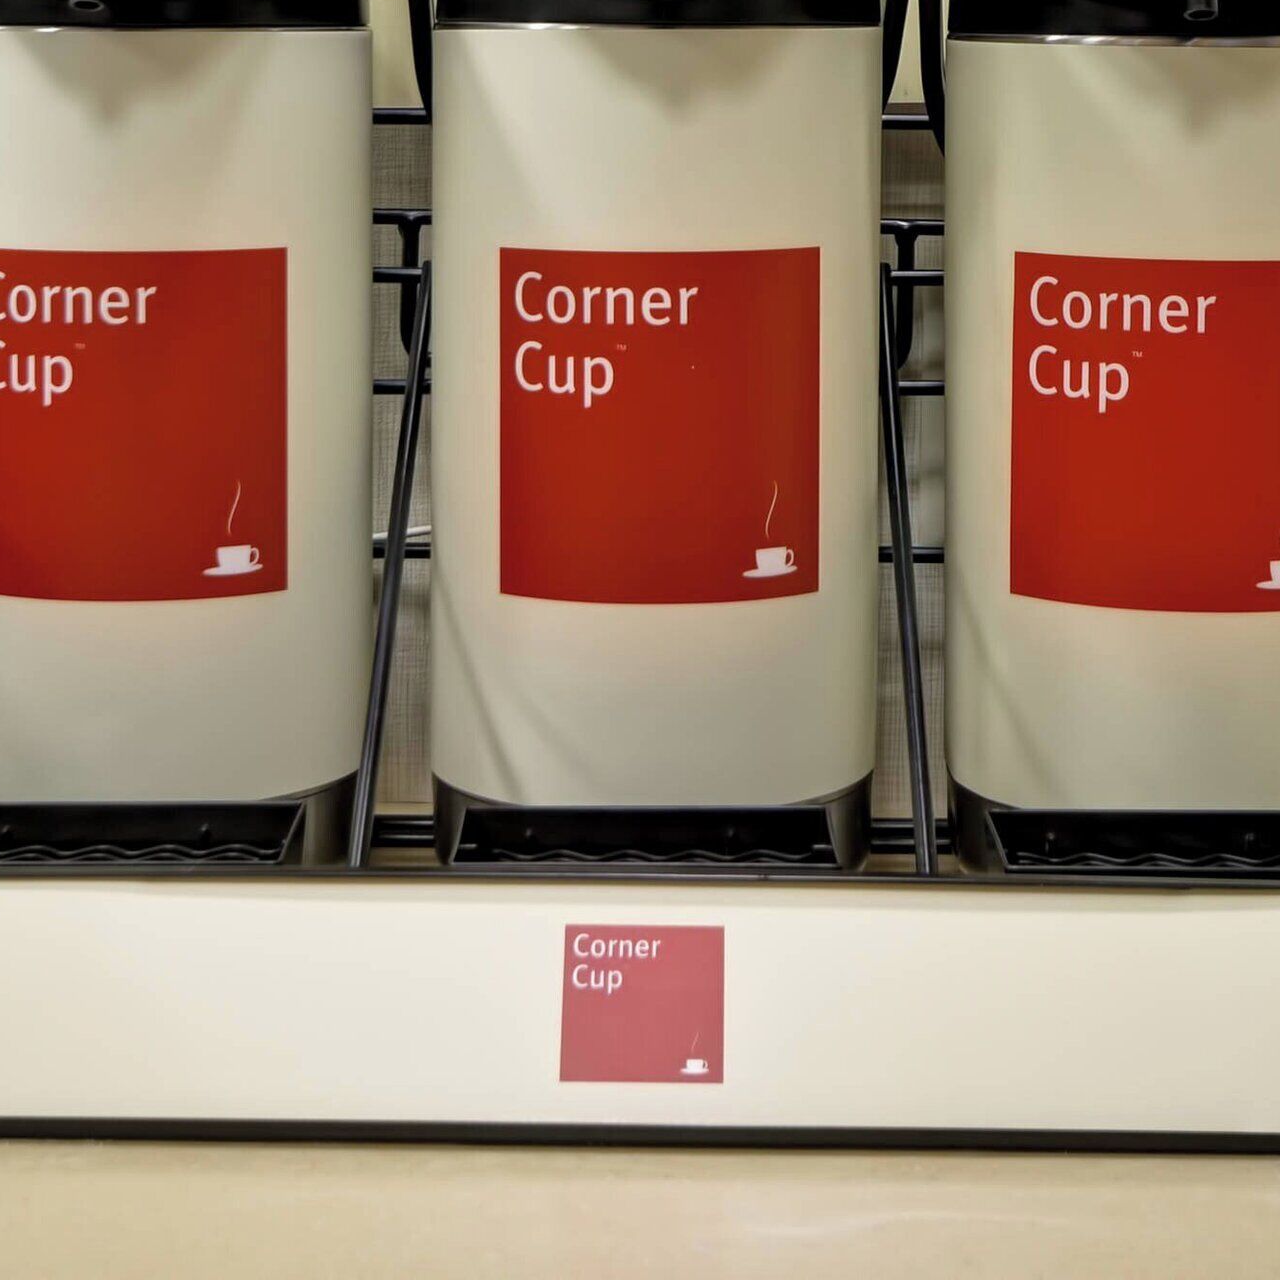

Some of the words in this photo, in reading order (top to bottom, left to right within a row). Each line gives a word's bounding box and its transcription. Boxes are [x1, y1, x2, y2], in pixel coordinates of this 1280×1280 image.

[514, 271, 699, 326] Corner
[1029, 275, 1217, 334] Corner
[514, 340, 615, 409] Cup
[1028, 344, 1130, 414] Cup
[573, 932, 662, 959] Corner
[571, 963, 623, 995] Cup
